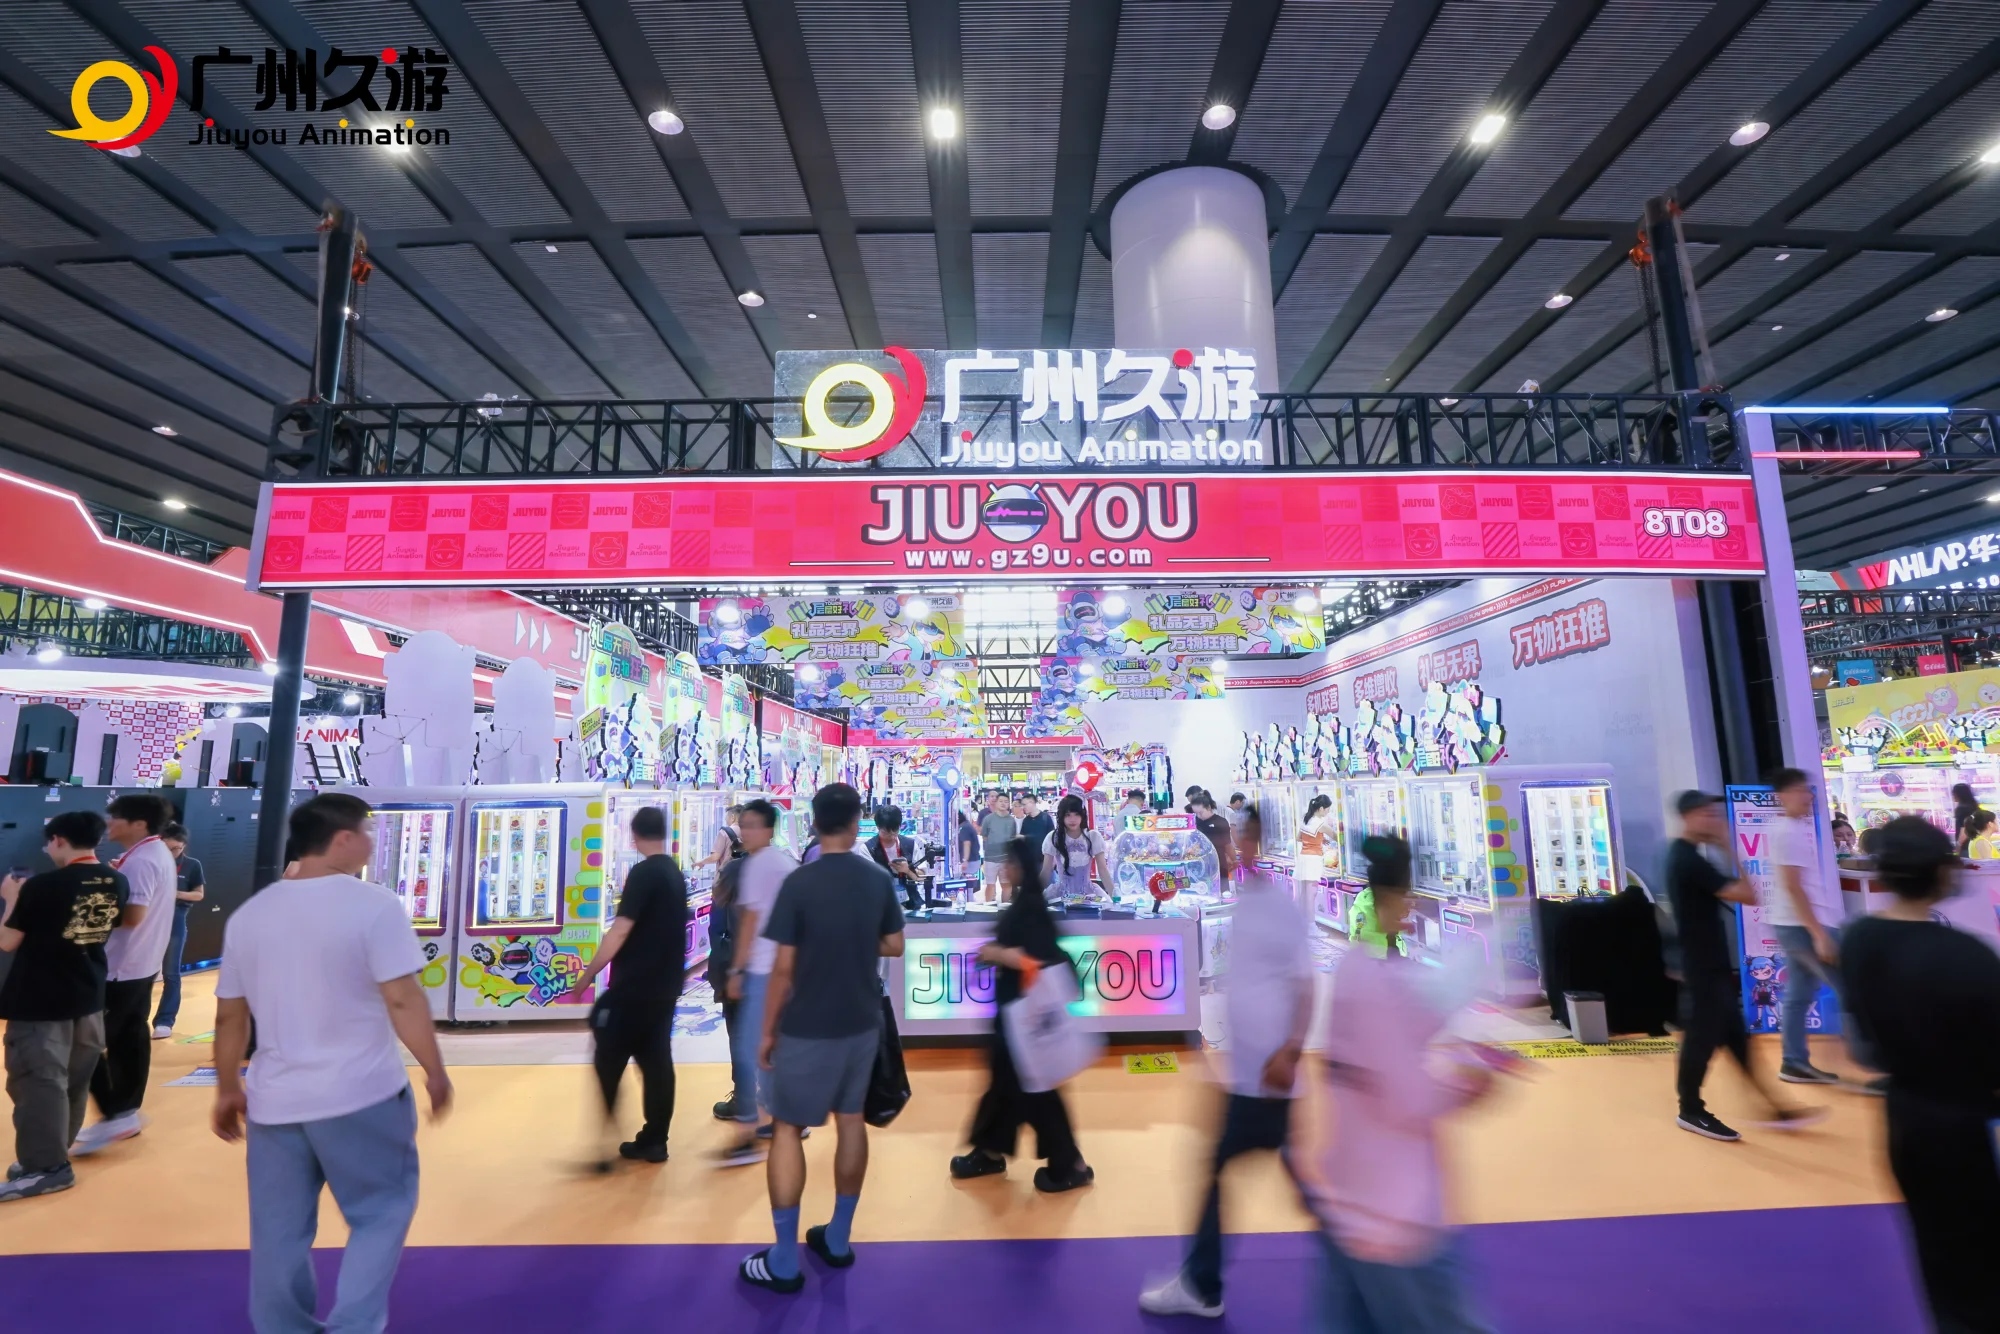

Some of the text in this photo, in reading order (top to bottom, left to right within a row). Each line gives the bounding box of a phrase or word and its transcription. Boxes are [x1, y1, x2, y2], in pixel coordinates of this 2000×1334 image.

[940, 347, 1259, 424] 广州久游
[940, 429, 1263, 468] Jiuyou Animation
[593, 506, 627, 516] JIUYOU
[1402, 498, 1434, 507] JIUYOU
[1481, 498, 1513, 507] JIUYOU
[1557, 498, 1588, 507] JIUYOU
[271, 509, 305, 520] JIUYOU
[352, 509, 386, 519] JIUYOU
[432, 508, 465, 518] JIUYOU
[513, 507, 547, 517] JIUYOU
[1645, 508, 1728, 537] 8T08
[1968, 533, 2000, 563] 华
[904, 544, 1153, 571] www.gz9u.com
[791, 621, 860, 639] 礼品无界
[1149, 614, 1218, 631] 礼品无界
[590, 618, 631, 657] 礼品无界
[1512, 603, 1607, 662] 万物狂推
[810, 641, 878, 658] 万物狂推
[1169, 634, 1239, 651] 万物狂推
[1419, 643, 1480, 686] 礼品无界
[1354, 669, 1398, 704] 多维增收
[1306, 687, 1339, 714] 多机联营
[304, 728, 358, 742] ANIMA
[530, 969, 585, 1004] TOWE
